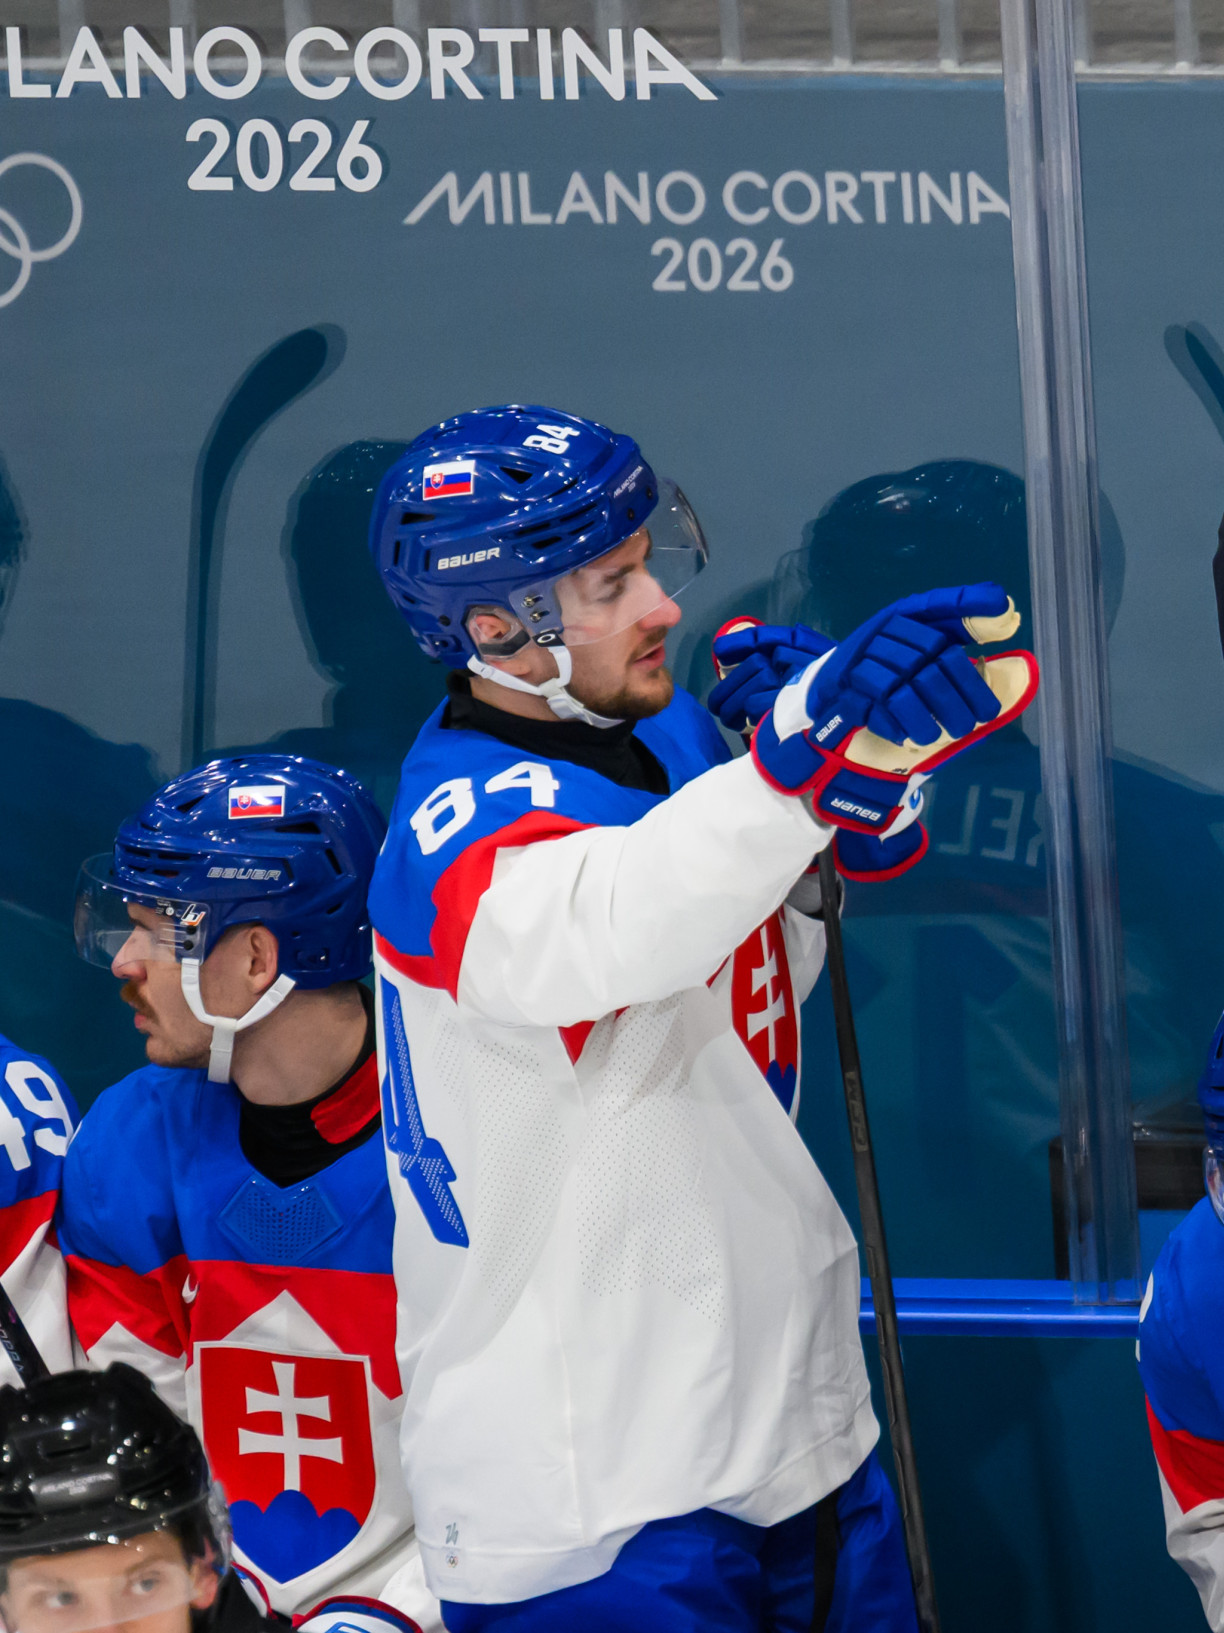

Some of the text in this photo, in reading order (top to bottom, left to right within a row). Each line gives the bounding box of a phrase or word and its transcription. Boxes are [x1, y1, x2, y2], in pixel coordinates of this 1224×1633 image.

[7, 26, 719, 100] LANO CORTINA
[186, 118, 383, 192] 2026
[402, 170, 1011, 226] MILANO CORTINA
[651, 237, 795, 292] 2026
[522, 424, 580, 455] 84
[437, 546, 500, 570] BAUER
[815, 714, 844, 743] BAUER
[409, 760, 560, 856] 84
[830, 797, 882, 823] BAUER
[206, 866, 281, 881] BAUER
